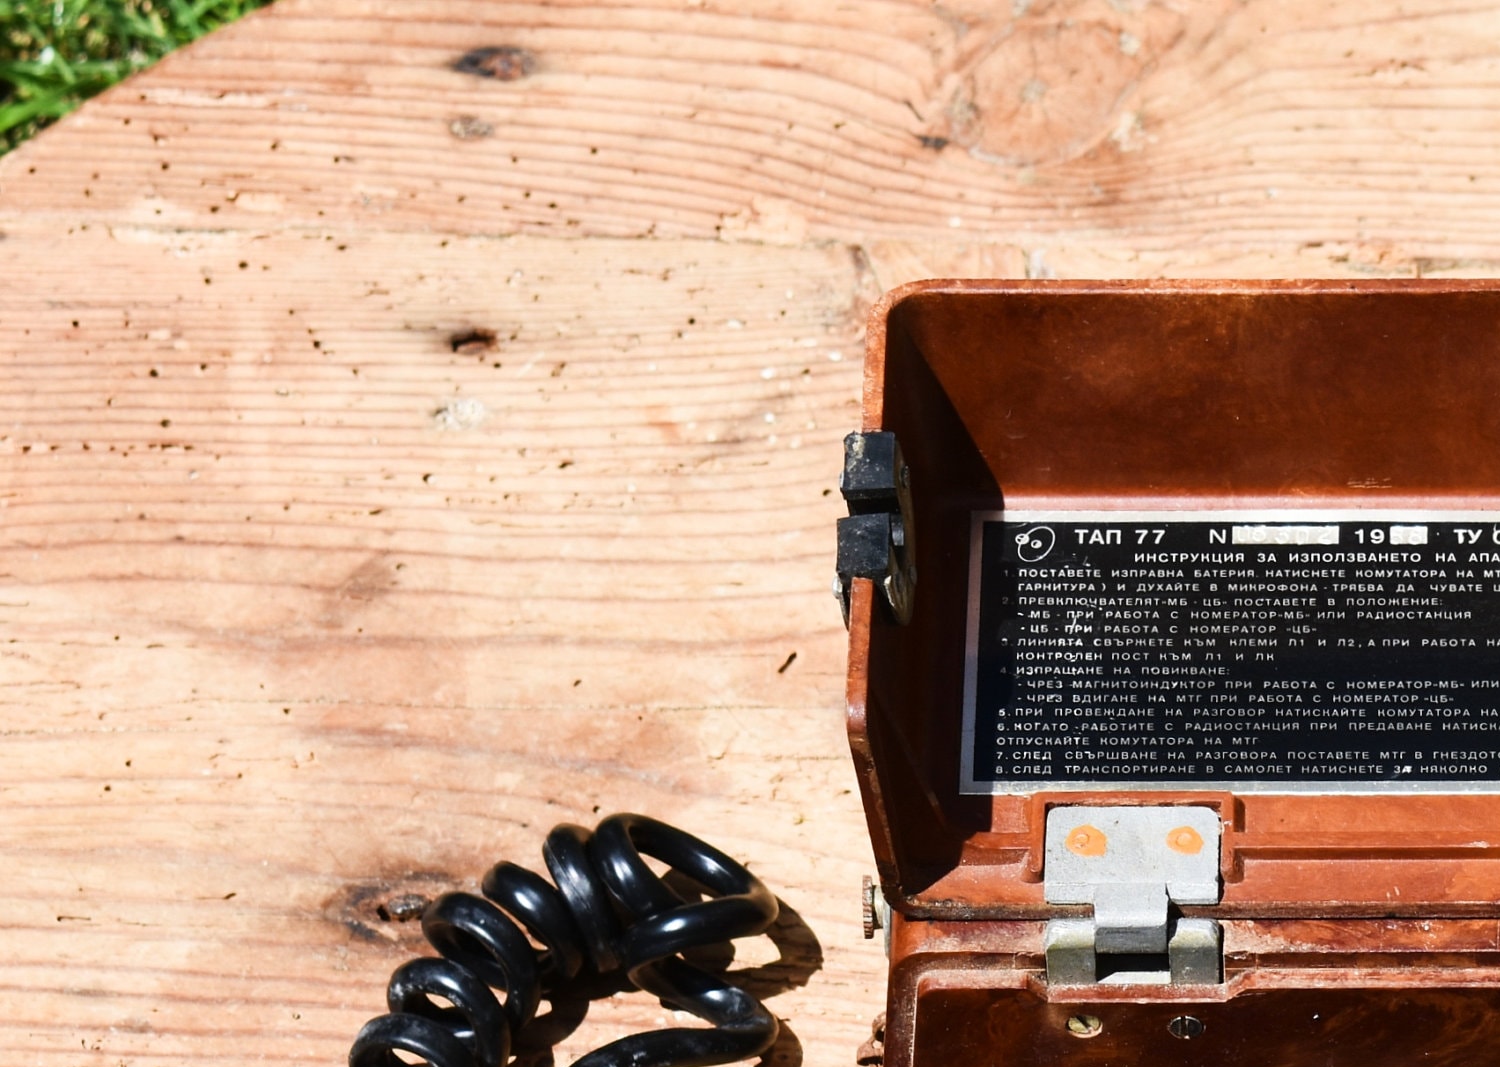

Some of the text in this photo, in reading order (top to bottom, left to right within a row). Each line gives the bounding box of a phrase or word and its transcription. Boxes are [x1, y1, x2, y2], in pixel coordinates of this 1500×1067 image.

[1073, 528, 1122, 546] ТАП
[1134, 528, 1166, 546] 77
[1208, 528, 1227, 546] N
[1452, 528, 1484, 546] ТУ
[1134, 552, 1245, 565] ИНСТРУКЦИЯ
[1256, 552, 1277, 564] ЗА
[1288, 552, 1422, 564] ИЗПОЛЗВАНЕТО
[1434, 552, 1457, 564] НА
[1017, 568, 1102, 579] ПОСТАВЕТЕ
[1111, 568, 1185, 579] ИЗПРАВНА
[1265, 568, 1346, 579] НАТИСНЕТЕ
[1355, 568, 1447, 579] КОМУТАТОРА
[1455, 568, 1475, 579] НА
[1135, 581, 1201, 594] ДУХАЙТЕ
[1227, 582, 1319, 593] МИКРОФОНА
[1331, 582, 1385, 593] ТРЯБВА
[1395, 582, 1415, 594] ДА
[1429, 582, 1484, 593] ЧУВАТЕ
[1233, 597, 1443, 607] ПОСТАВЕТЕ ПОЛОЖЕНИЕ:
[1066, 610, 1472, 621] ПРИ РАБОТА ИЛИ РАДИОСТАНЦИЯ
[1064, 624, 1277, 634] ПРИ РАБОТА НОМЕРАТОР
[1016, 637, 1084, 647] ЛИНИЯТА
[1092, 637, 1174, 647] СВЪРЖЕТЕ
[1183, 637, 1216, 647] КЪМ
[1229, 637, 1278, 647] КЛЕМИ
[1382, 637, 1410, 647] ПРИ
[1421, 637, 1477, 647] РАБОТА
[1016, 652, 1103, 662] КОНТРОЛЕН
[1111, 652, 1150, 662] ПОСТ
[1159, 652, 1192, 662] КЪМ
[1026, 680, 1064, 690] ЧРЕЗ
[1224, 680, 1253, 690] ПРИ
[1263, 680, 1318, 690] РАБОТА
[1470, 680, 1500, 690] ИЛИ
[1072, 694, 1138, 705] ВДИГАНЕ
[1175, 694, 1202, 704] МТГ
[1210, 694, 1238, 704] ПРИ
[1248, 694, 1303, 704] РАБОТА
[1332, 694, 1419, 704] НОМЕРАТОР
[1054, 708, 1155, 719] ПРОВЕЖДАНЕ
[1193, 708, 1266, 718] РАЗГОВОР
[1275, 707, 1367, 718] НАТИСКАЙТЕ
[1377, 708, 1471, 718] КОМУТАТОРА
[1184, 722, 1300, 733] РАДИОСТАНЦИЯ
[1309, 722, 1338, 732] ПРИ
[1348, 722, 1433, 733] ПРЕДАВАНЕ
[995, 735, 1259, 746] ОТПУСКАЙТЕ КОМУТАТОРА МТГ
[1064, 750, 1158, 760] СВЪРШВАНЕ
[1195, 750, 1278, 760] РАЗГОВОРА
[1287, 750, 1370, 760] ПОСТАВЕТЕ
[1379, 750, 1407, 760] МТГ
[1064, 764, 1196, 774] ТРАНСПОРТИРАНЕ
[1224, 764, 1293, 774] САМОЛЕТ
[1301, 764, 1384, 774] НАТИСНЕТЕ
[1419, 764, 1488, 774] НЯКОЛКО
